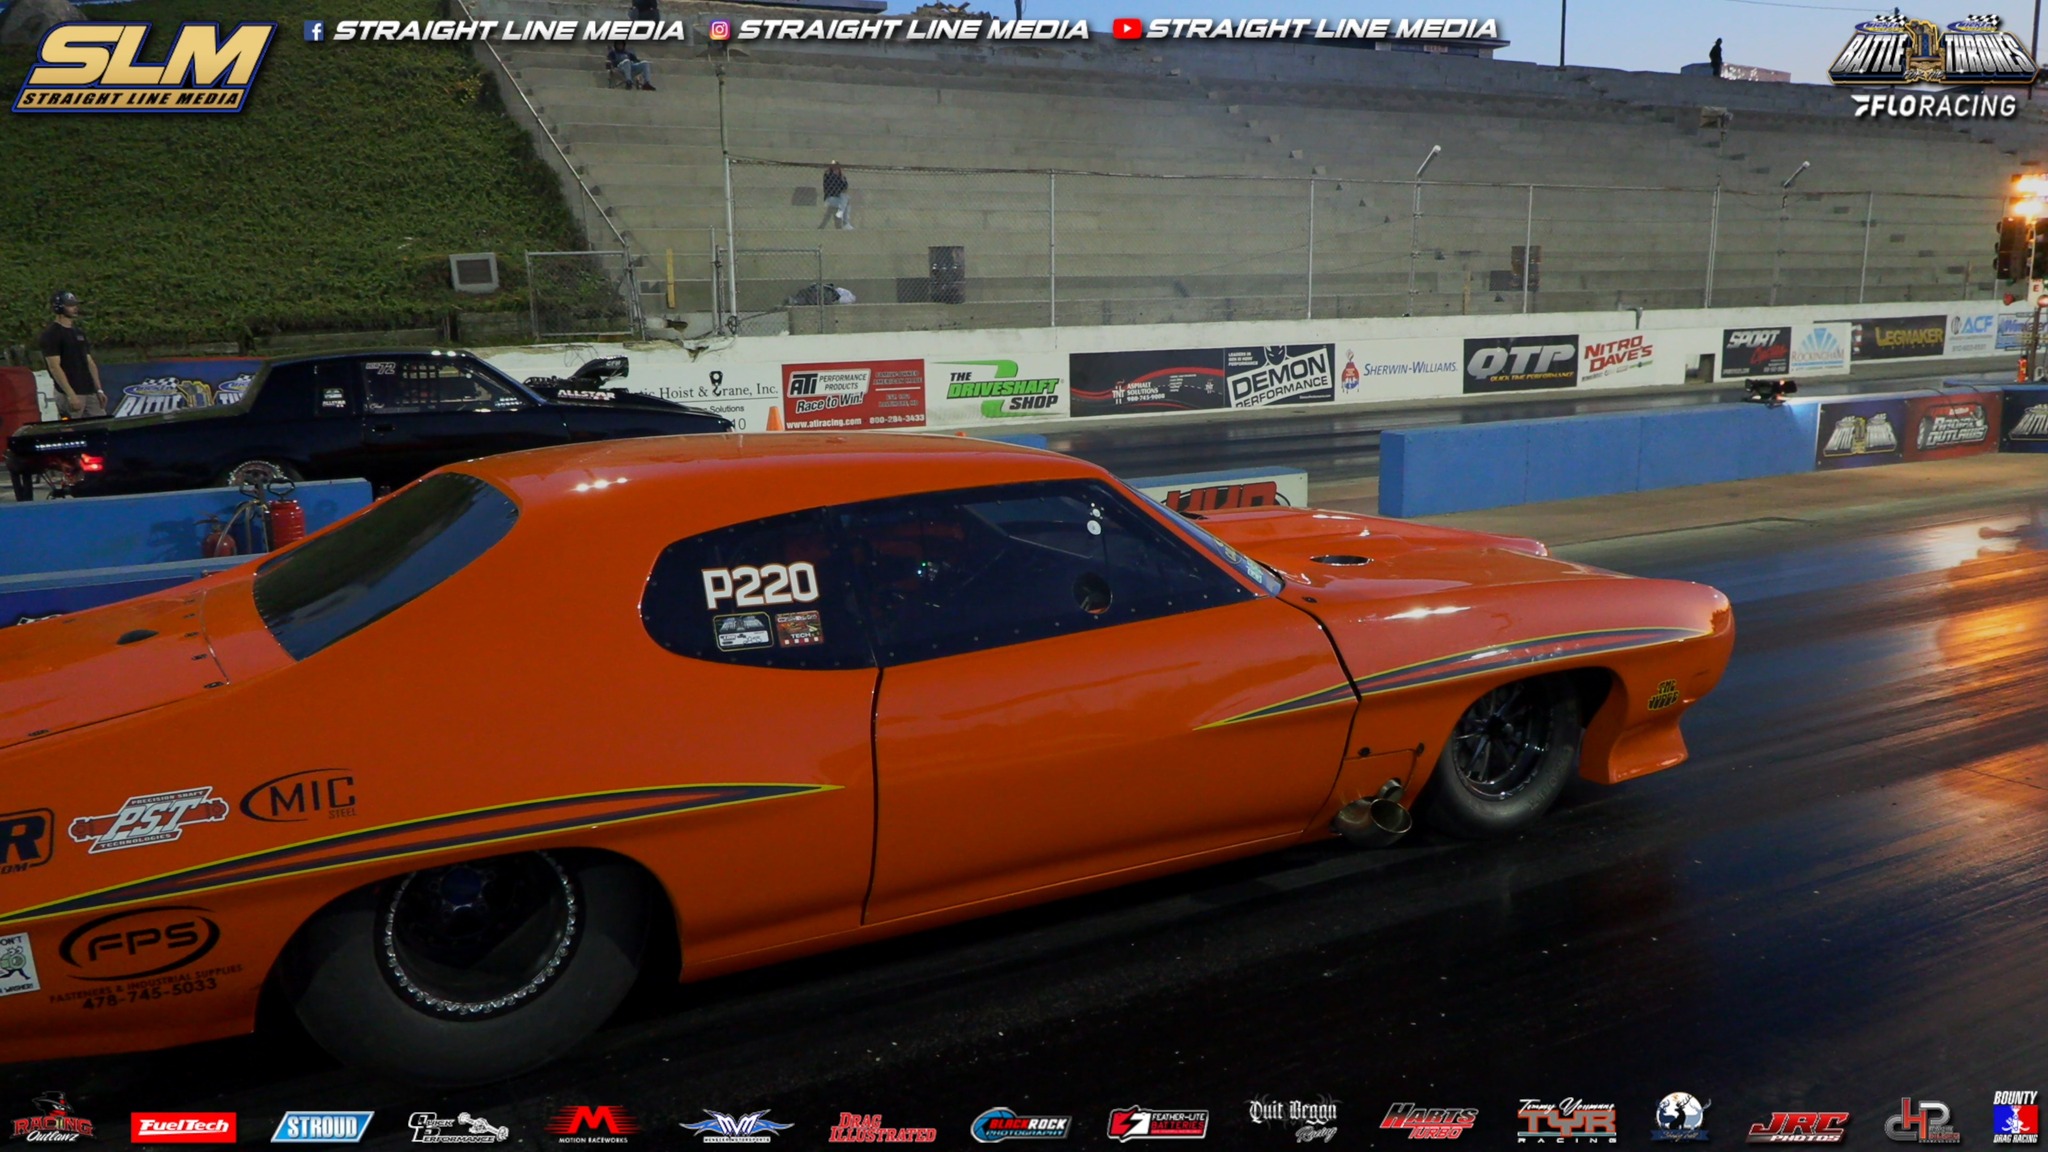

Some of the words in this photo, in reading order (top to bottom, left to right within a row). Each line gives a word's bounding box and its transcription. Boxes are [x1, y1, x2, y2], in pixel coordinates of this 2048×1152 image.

[1961, 315, 1994, 333] ACF
[1727, 330, 1780, 348] SPORT
[1875, 327, 1943, 346] LEGMAKER
[1584, 335, 1643, 360] NITRO
[1792, 349, 1845, 361] ROCKINGHAM
[1467, 344, 1576, 380] QTP
[1589, 345, 1653, 373] DAVE'S
[377, 362, 396, 375] 72
[951, 372, 972, 381] THE
[1232, 353, 1327, 401] DEMON
[1526, 371, 1574, 380] PERFORMANCE
[820, 374, 867, 383] PERFORMANCE
[825, 383, 858, 391] PRODUCTS
[558, 389, 616, 400] ALLSTAR
[660, 387, 697, 399] Hoist
[699, 387, 708, 397] &
[757, 384, 778, 395] Inc.
[947, 379, 1059, 399] DRIVESHAFT
[1236, 376, 1328, 407] PERFORMANCE
[710, 404, 744, 413] Solutions
[796, 399, 824, 413] Race
[827, 396, 837, 408] to
[840, 391, 864, 406] Win!
[1010, 395, 1058, 410] SHOP
[786, 418, 861, 429] www.atiracing.com
[1926, 426, 1987, 446] OUTLAWS
[702, 562, 819, 610] P220
[131, 794, 175, 804] PRECISION
[177, 790, 204, 798] SHAFT
[269, 775, 356, 817] MIC
[97, 797, 205, 843] PST
[329, 808, 357, 819] STEEL
[100, 834, 172, 848] TECHNOLOGIES
[0, 935, 23, 946] ON'T
[88, 921, 198, 961] FPS
[50, 987, 112, 1004] FASTENERS
[116, 984, 124, 992] &
[128, 973, 191, 990] INDUSTRIAL
[196, 964, 243, 979] SUPPLIES
[82, 978, 217, 1009] 478-745-5033
